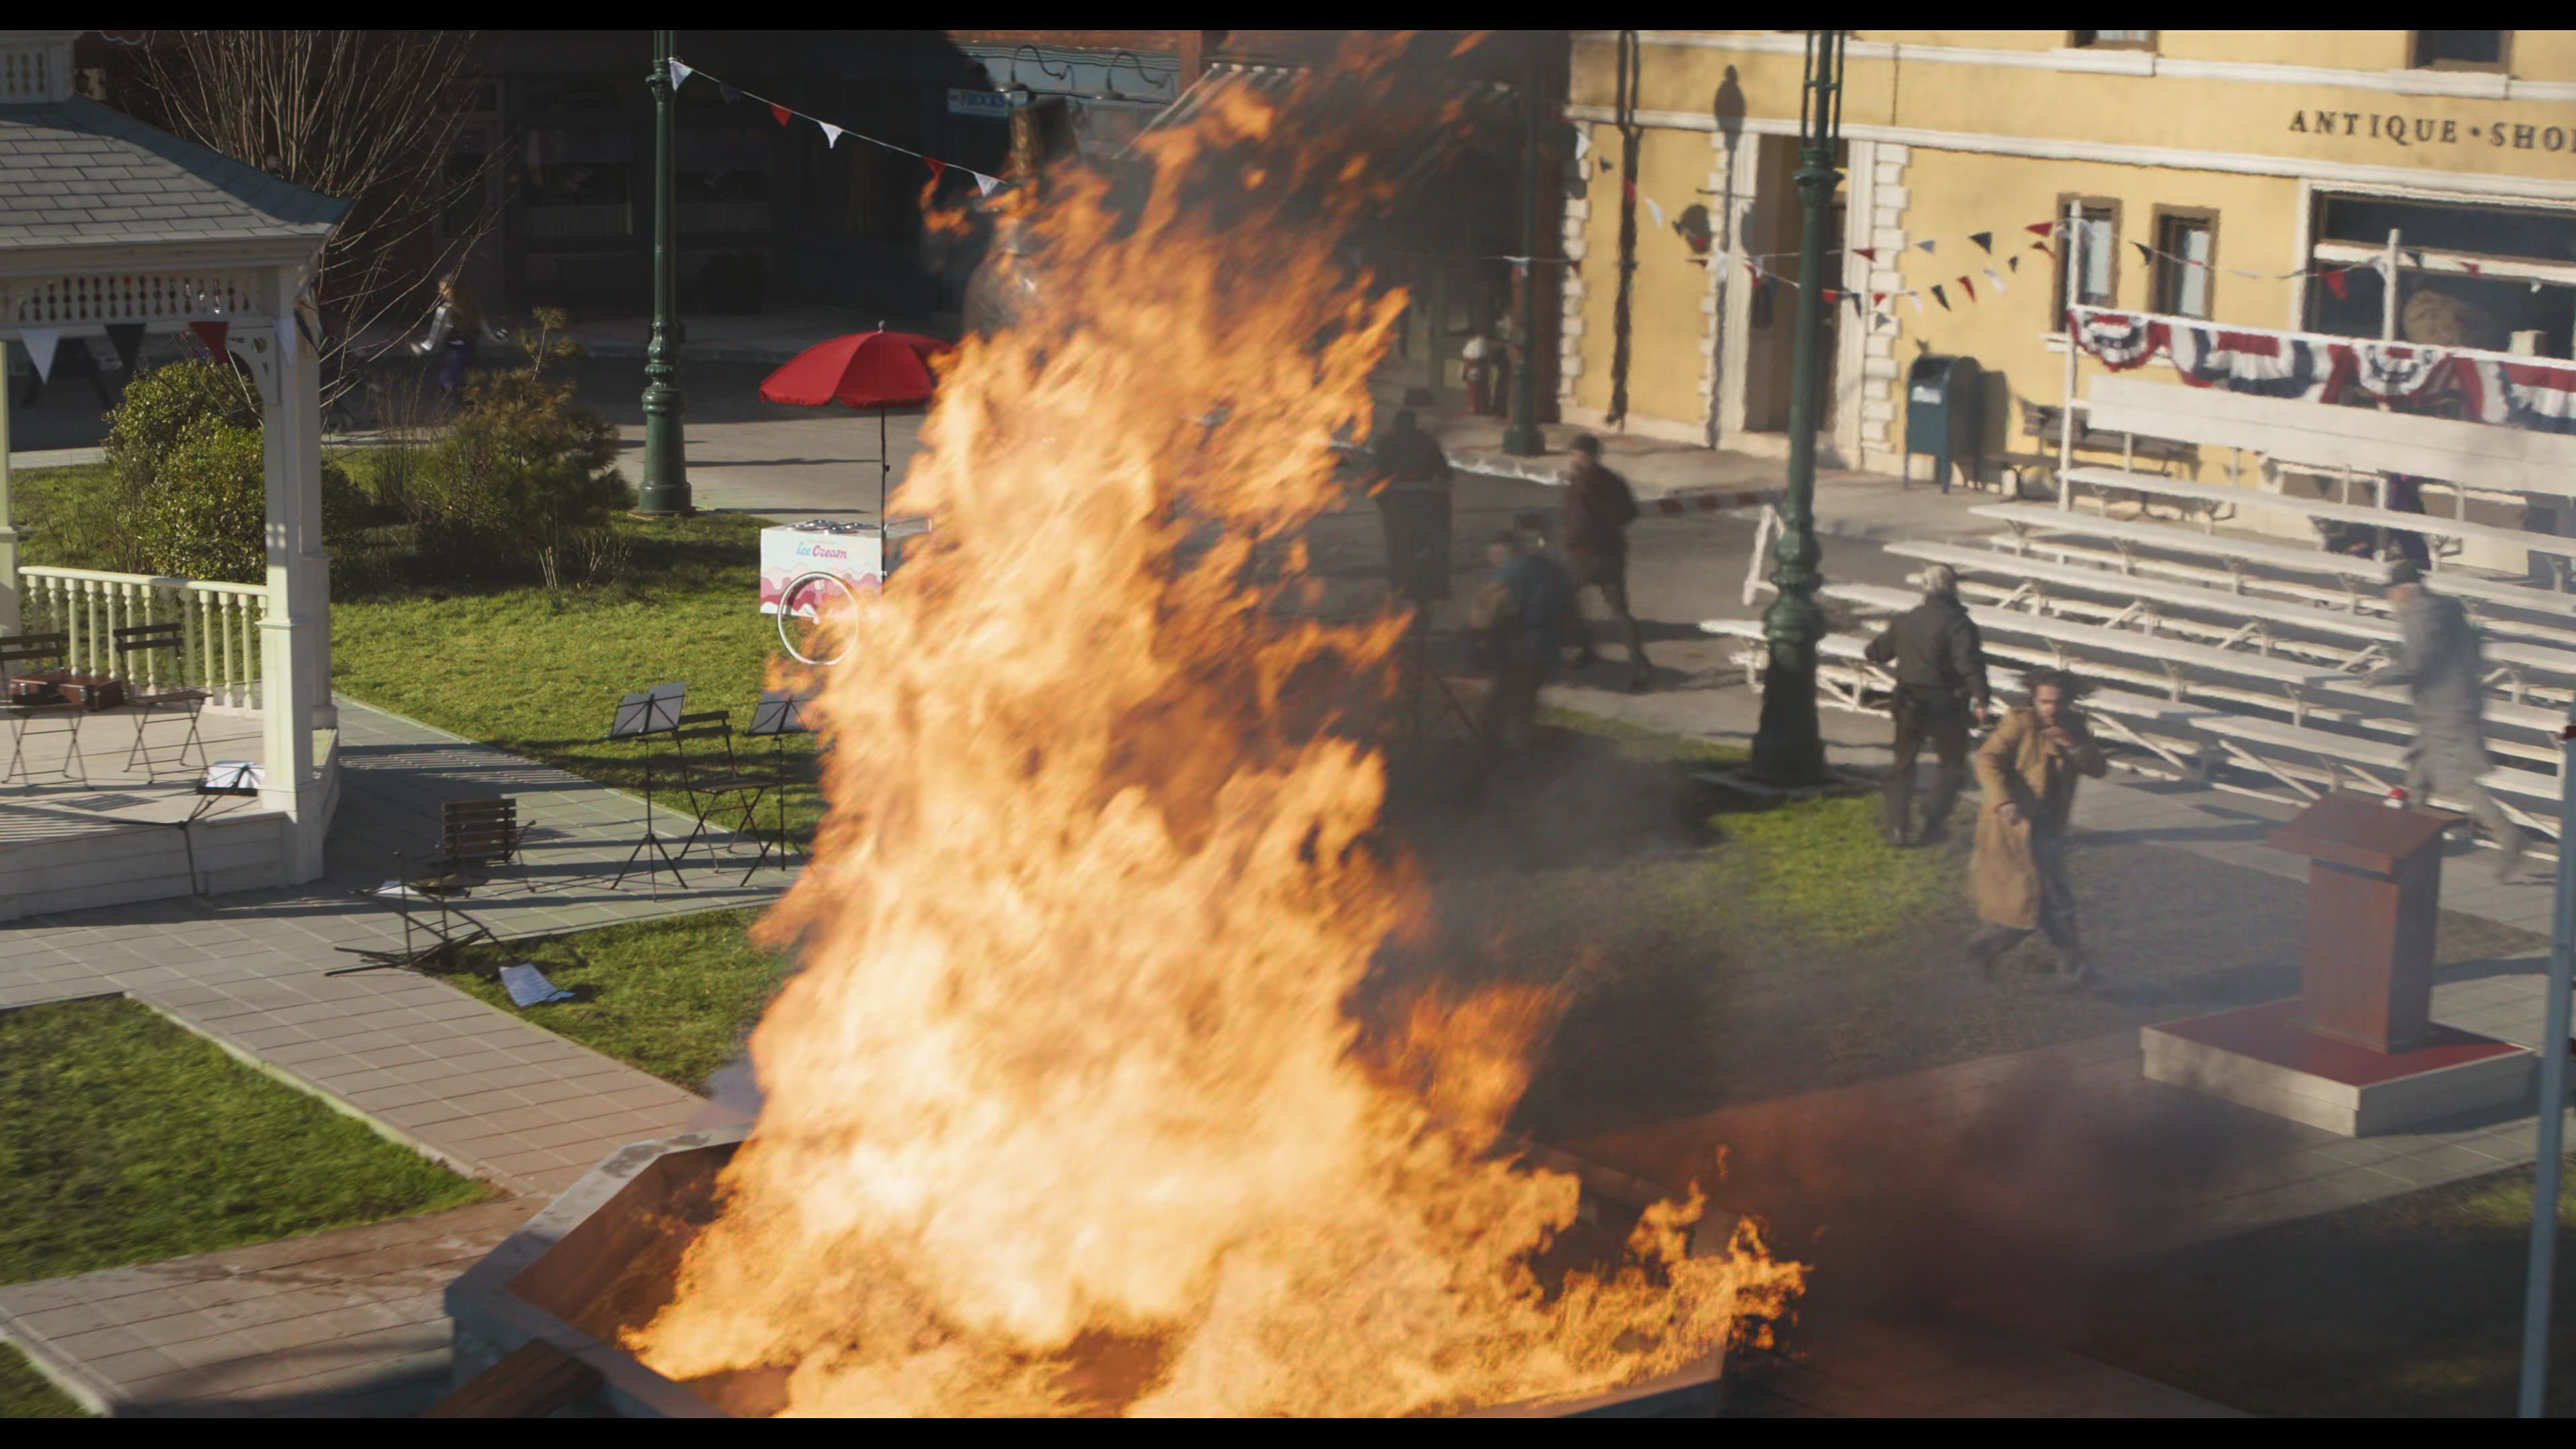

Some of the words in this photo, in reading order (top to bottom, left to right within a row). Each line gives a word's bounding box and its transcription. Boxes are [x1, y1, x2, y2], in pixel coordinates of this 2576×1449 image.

[2288, 109, 2458, 146] ANTIQUE
[2489, 121, 2576, 154] SHO
[812, 545, 847, 558] Cream
